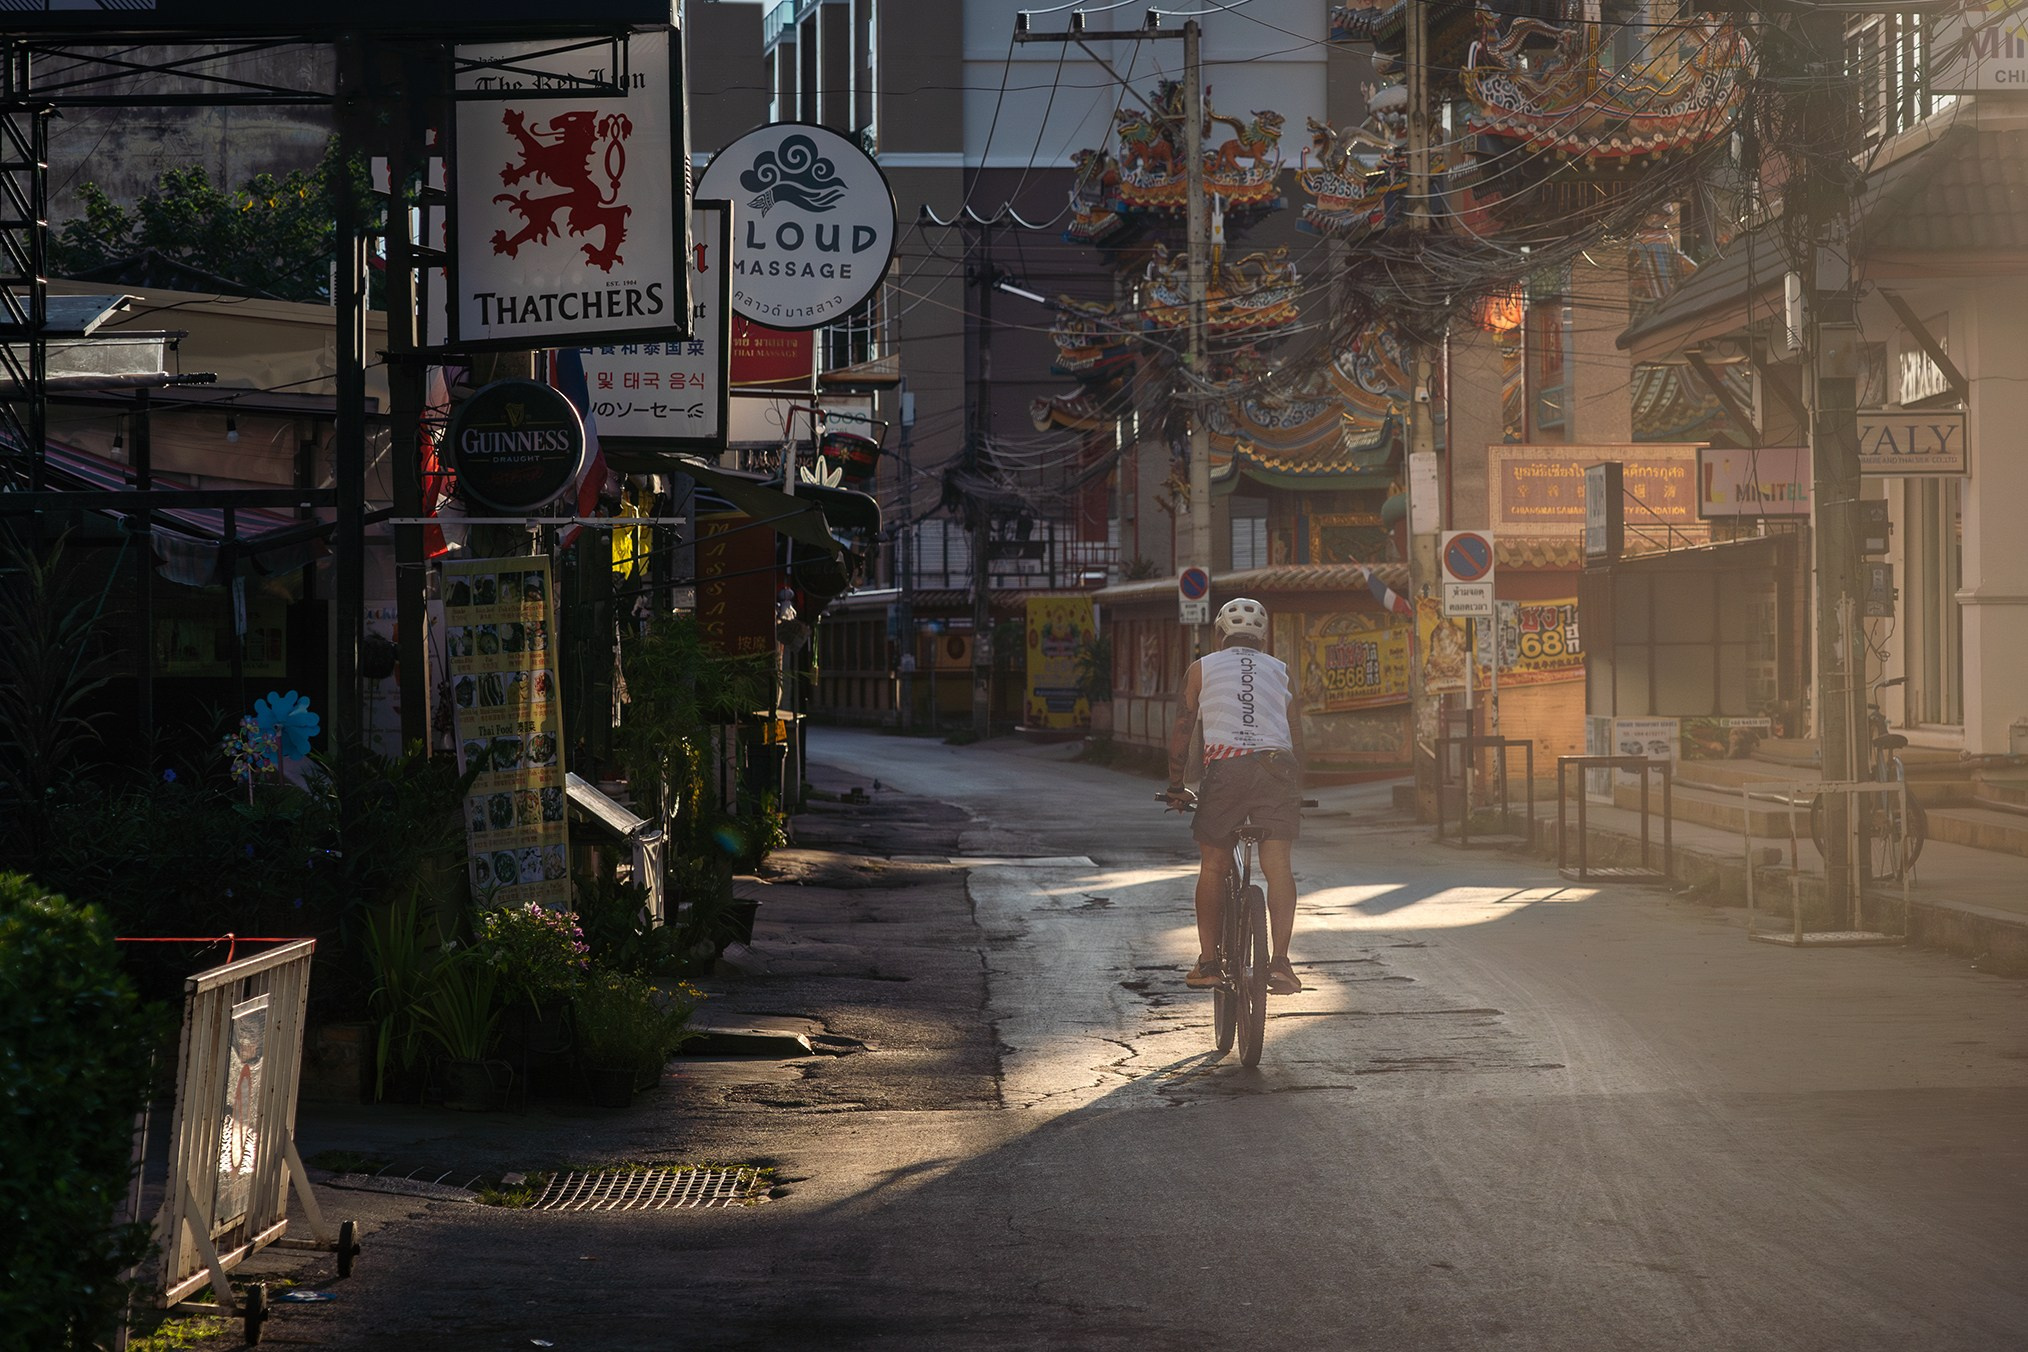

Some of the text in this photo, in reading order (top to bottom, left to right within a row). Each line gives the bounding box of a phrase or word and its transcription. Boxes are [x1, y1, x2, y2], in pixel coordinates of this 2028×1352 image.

[1995, 69, 2028, 83] CHI
[737, 220, 877, 254] LOUD
[733, 260, 852, 280] MASSAGE
[605, 279, 638, 288] EST. 1904
[473, 282, 664, 326] THATCHERS
[756, 349, 797, 358] MASSAGE
[597, 371, 614, 390] 및
[624, 371, 660, 390] 태국
[668, 371, 705, 390] 음식
[461, 427, 570, 454] GUINNESS
[492, 455, 541, 464] DRAUGHT
[1735, 482, 1809, 503] MINITEL
[1327, 665, 1365, 690] 2568
[1236, 656, 1259, 728] chiangmai
[478, 725, 495, 737] Thai
[496, 723, 513, 735] Food
